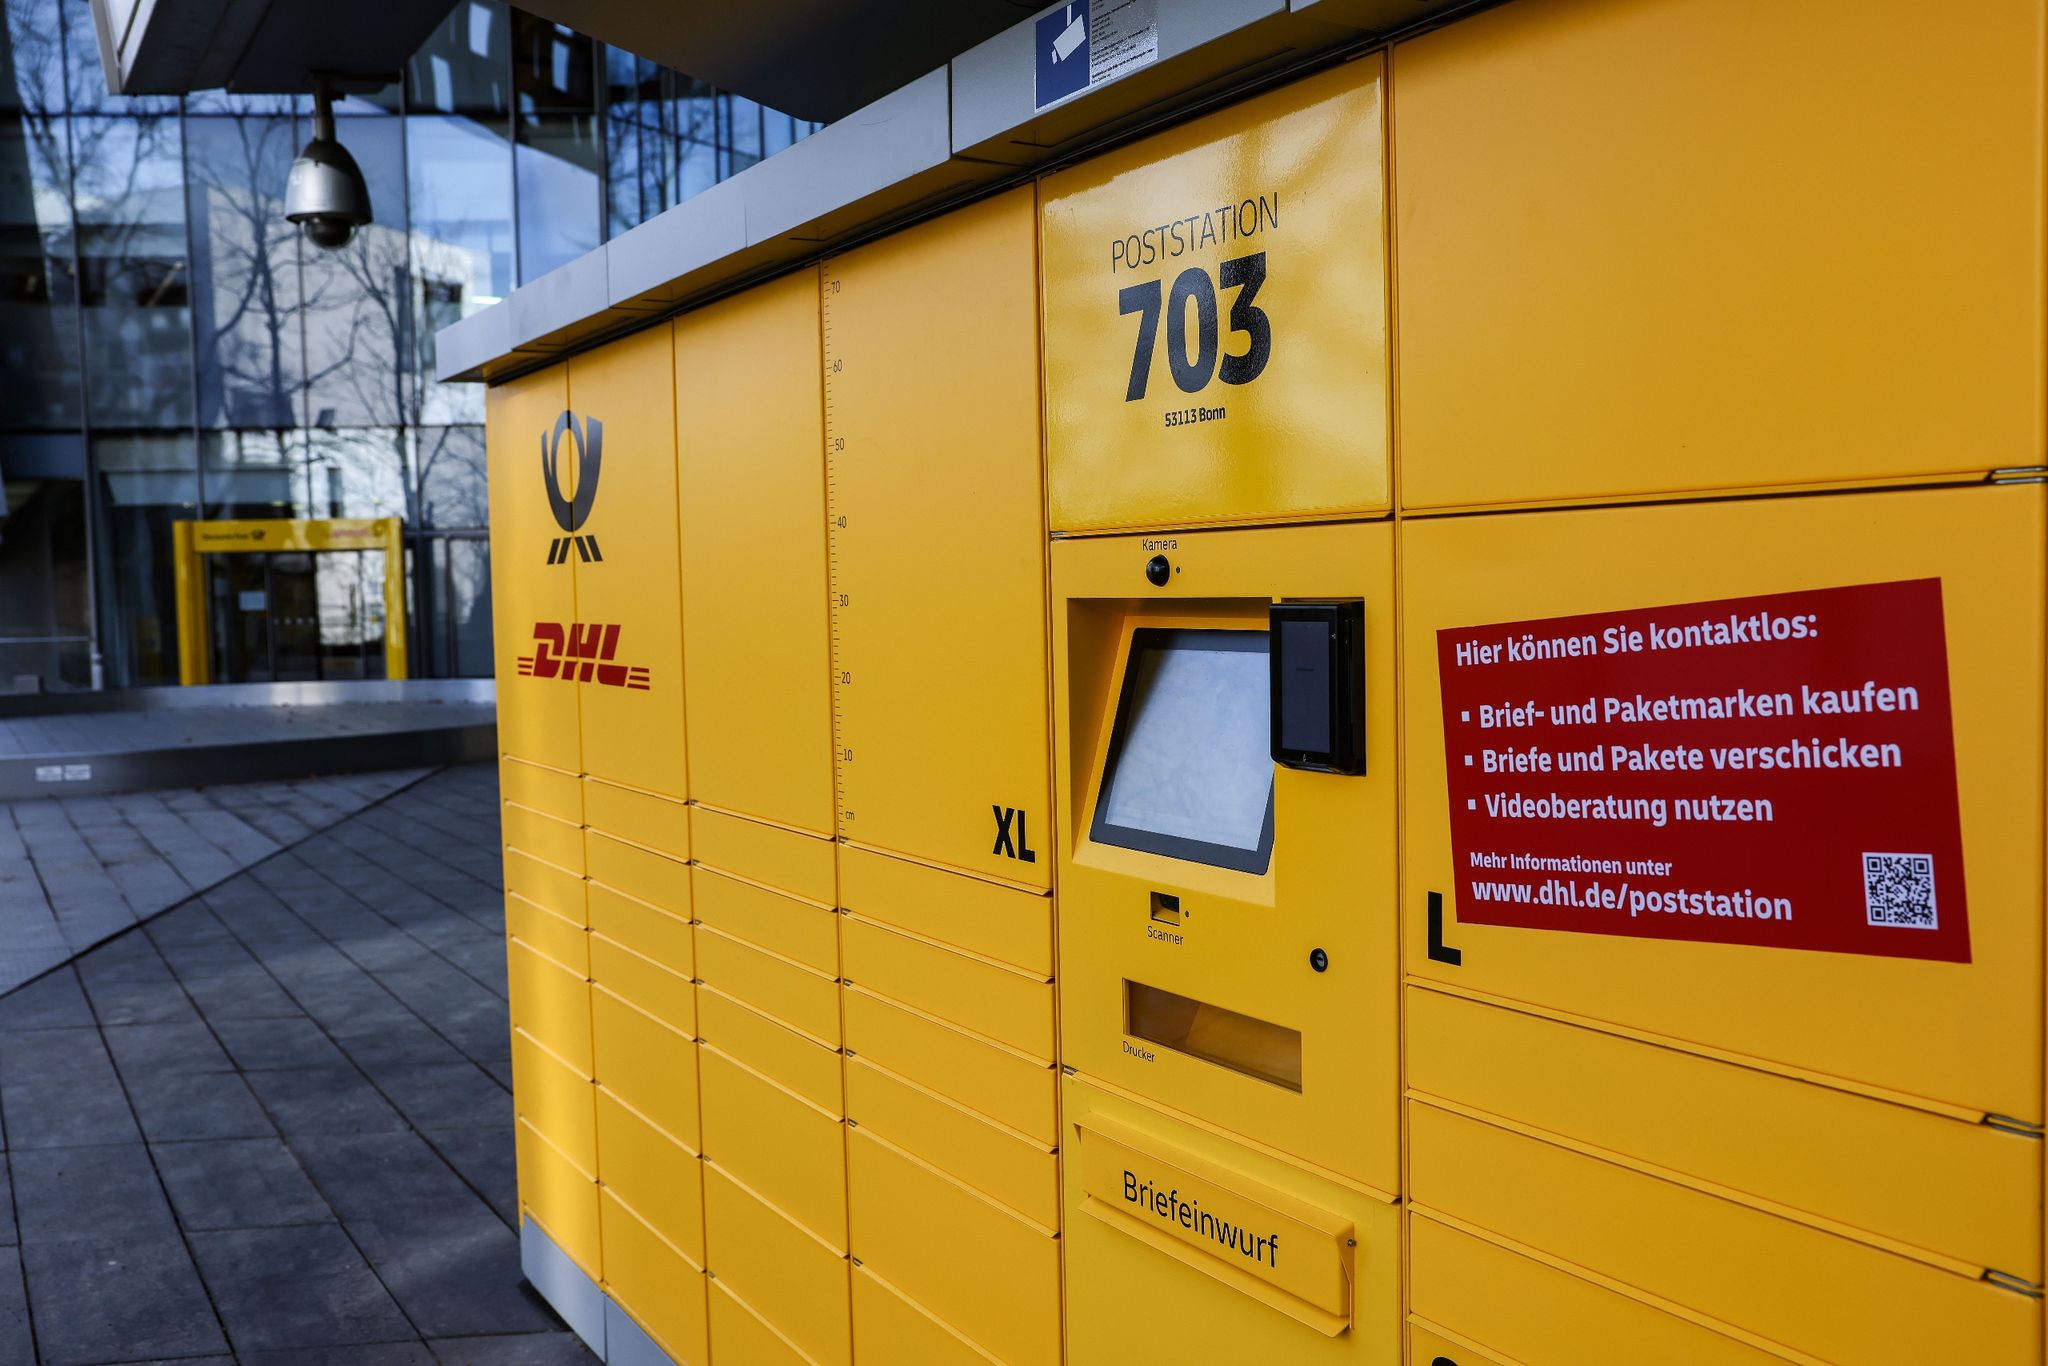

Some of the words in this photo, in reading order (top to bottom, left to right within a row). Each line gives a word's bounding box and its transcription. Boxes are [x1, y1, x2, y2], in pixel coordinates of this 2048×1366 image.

[1112, 191, 1279, 274] POSTSTATION
[831, 280, 841, 295] 70
[1118, 251, 1272, 403] 703
[833, 359, 843, 373] 60
[1165, 408, 1197, 427] 53113
[1198, 406, 1226, 423] Bonn
[835, 437, 845, 451] 50
[837, 515, 847, 529] 40
[1142, 537, 1178, 551] Kamera
[839, 594, 849, 607] 30
[1456, 639, 1503, 667] Hier
[1507, 635, 1597, 662] können
[1603, 624, 1644, 654] Sie
[1649, 611, 1818, 650] kontaktlos:
[533, 622, 630, 687] DHL
[841, 671, 851, 684] 20
[1479, 701, 1545, 729] Brief-
[1550, 698, 1597, 726] und
[1603, 689, 1794, 723] Paketmarken
[1801, 681, 1919, 715] kaufen
[843, 748, 853, 762] 10
[1482, 747, 1552, 773] Briefe
[1557, 745, 1605, 773] und
[1610, 744, 1704, 772] Pakete
[1709, 737, 1902, 770] verschicken
[845, 810, 855, 821] cm
[1484, 792, 1668, 827] Videoberatung
[1674, 795, 1774, 822] nutzen
[991, 803, 1036, 865] XL
[1470, 851, 1508, 869] Mehr
[1510, 852, 1622, 875] Informationen
[1625, 859, 1673, 876] unter
[1471, 878, 1793, 921] www.dhl.de/poststation
[1147, 925, 1185, 946] Scanner
[1427, 891, 1462, 967] L
[1122, 1040, 1156, 1063] Drucker
[1123, 1170, 1279, 1268] Briefeinwurf
